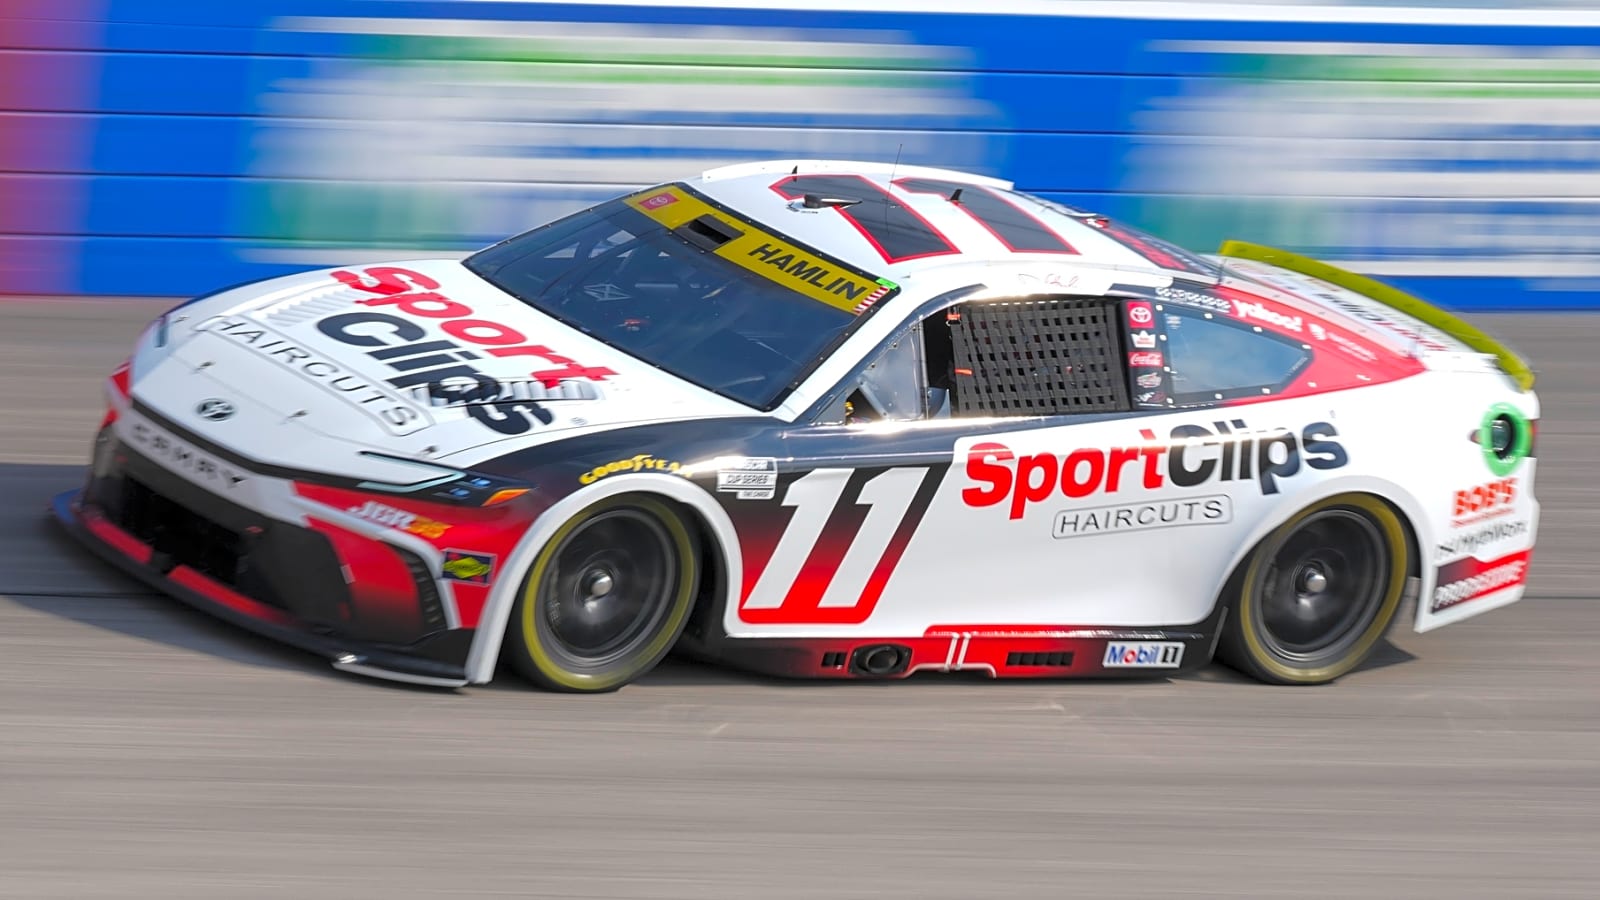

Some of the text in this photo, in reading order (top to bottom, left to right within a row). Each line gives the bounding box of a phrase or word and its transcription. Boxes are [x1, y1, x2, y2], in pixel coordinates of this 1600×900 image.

[769, 174, 1081, 264] 11
[748, 243, 867, 301] HAMLIN
[215, 318, 417, 426] HAIRCUTS
[317, 311, 554, 435] Clips
[329, 267, 618, 389] Sport
[741, 467, 930, 609] 11
[1060, 500, 1223, 534] HAIRCUTS
[1108, 645, 1159, 664] Mobil
